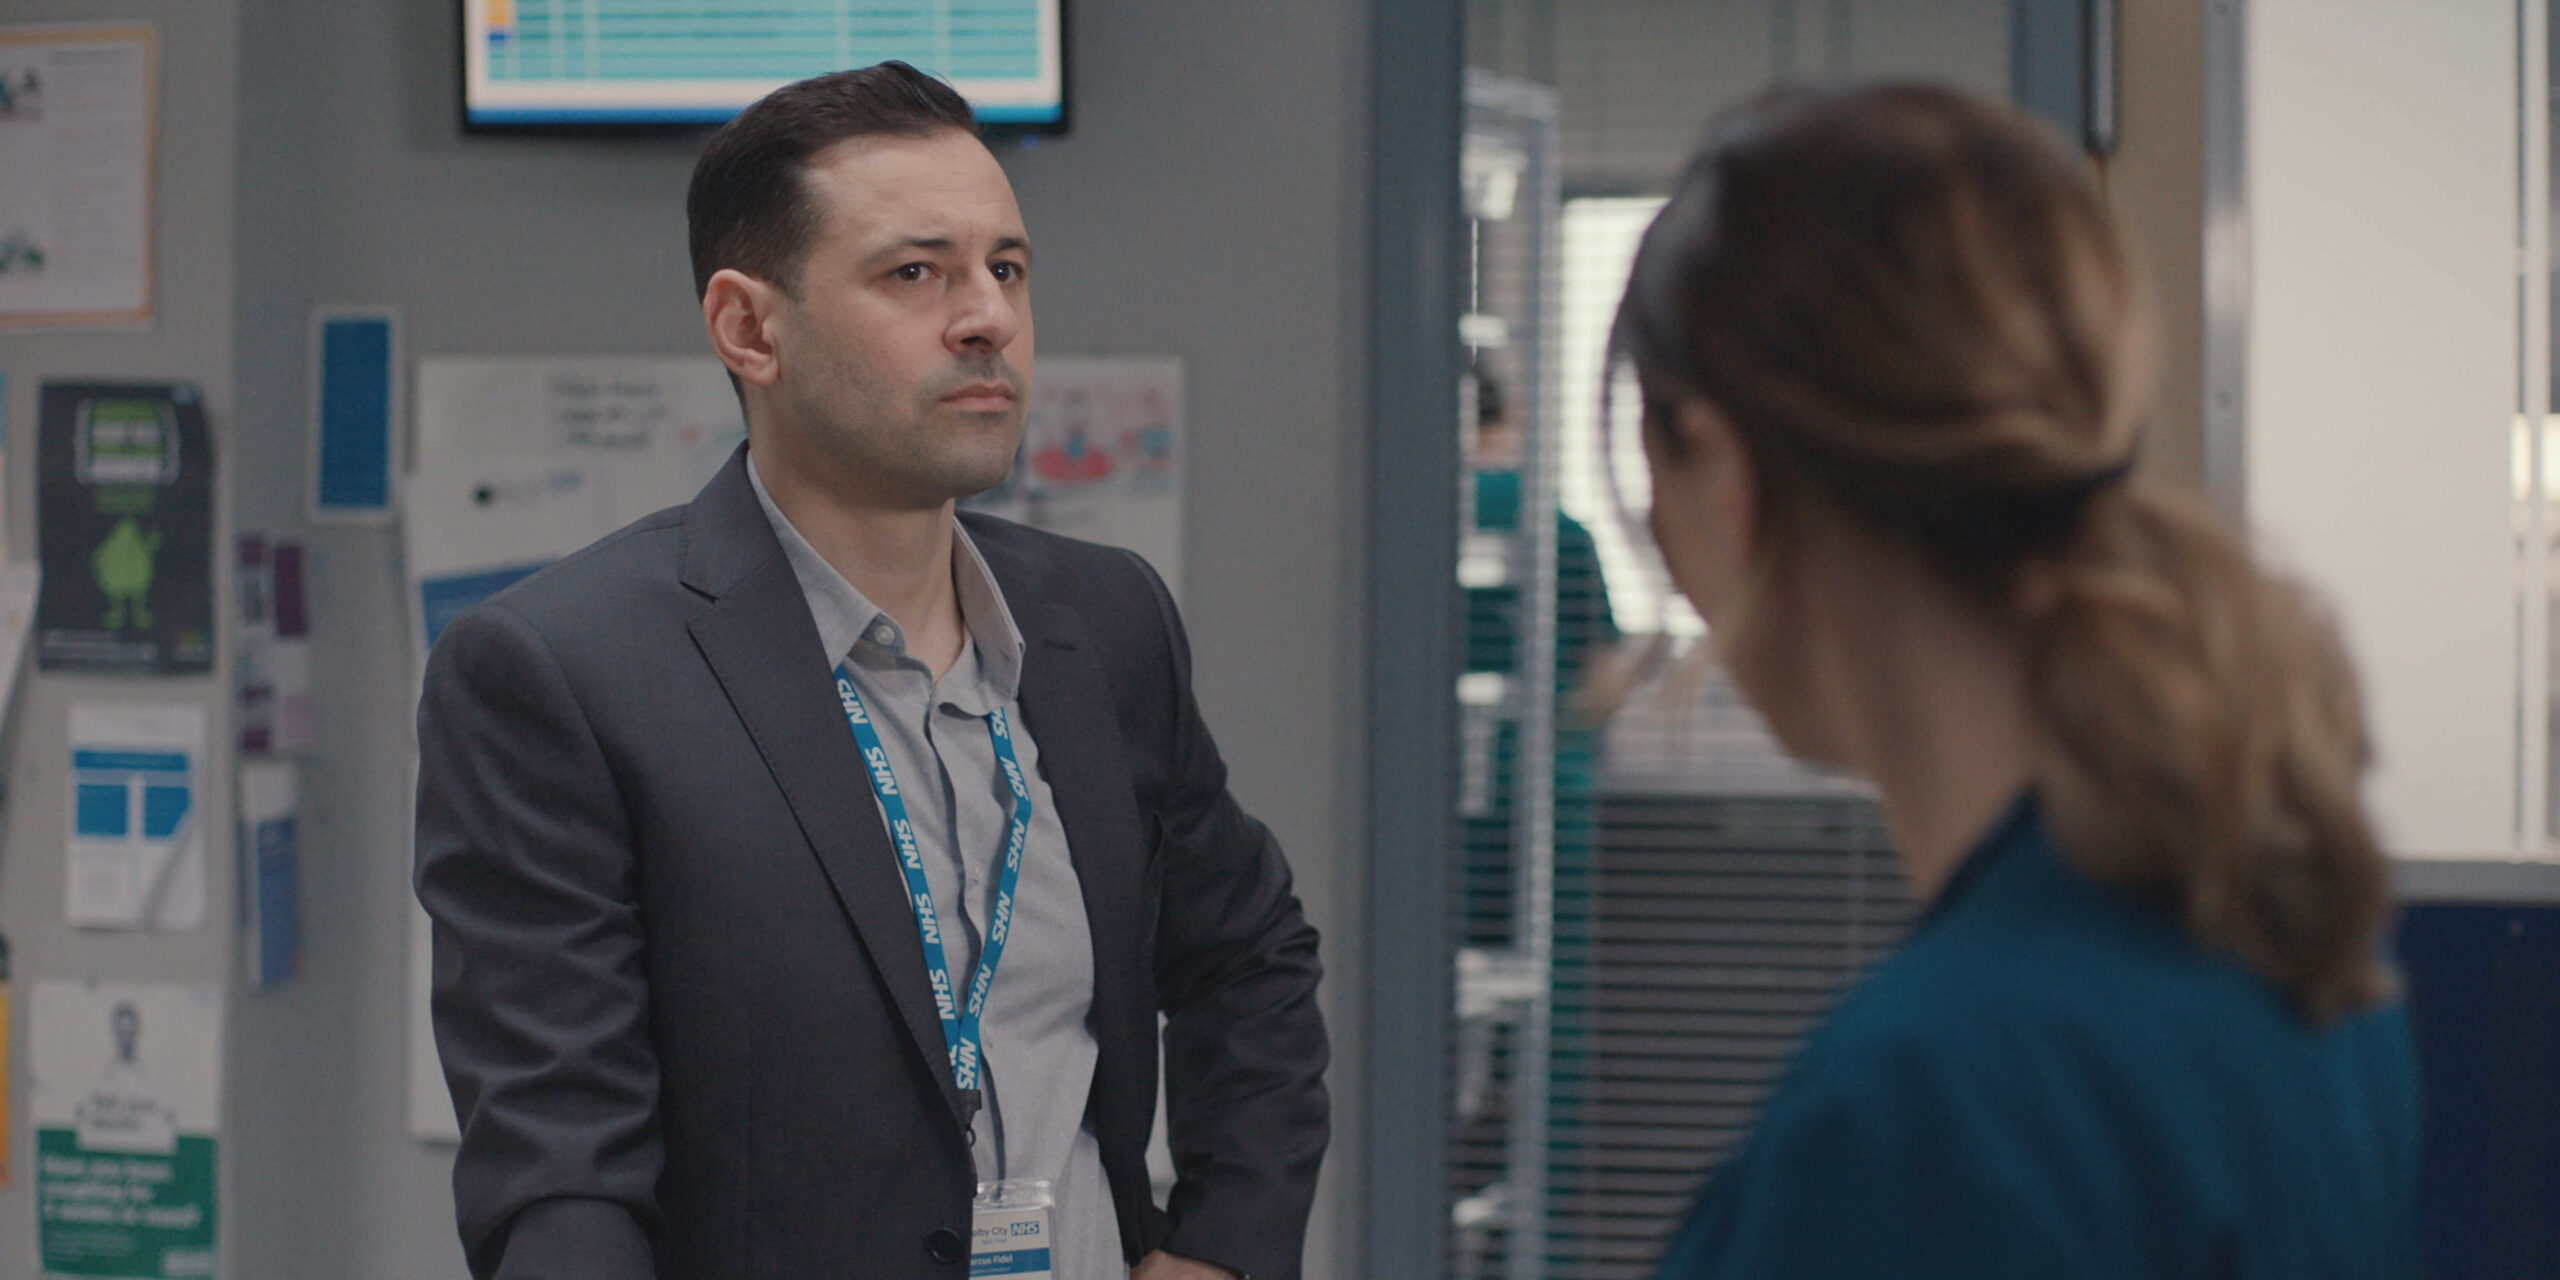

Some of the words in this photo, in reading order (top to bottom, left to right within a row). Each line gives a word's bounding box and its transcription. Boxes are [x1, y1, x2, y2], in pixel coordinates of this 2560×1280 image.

[837, 678, 868, 725] NHS
[864, 746, 898, 796] NHS
[1000, 756, 1029, 801] NHS
[894, 818, 921, 870] NHS
[1007, 818, 1025, 872] NHS
[915, 893, 939, 944] NHS
[992, 891, 1012, 945] NHS
[929, 968, 955, 1020] NHS
[968, 963, 992, 1018] NHS
[957, 1037, 976, 1090] NHS
[1011, 1222, 1039, 1236] NHS
